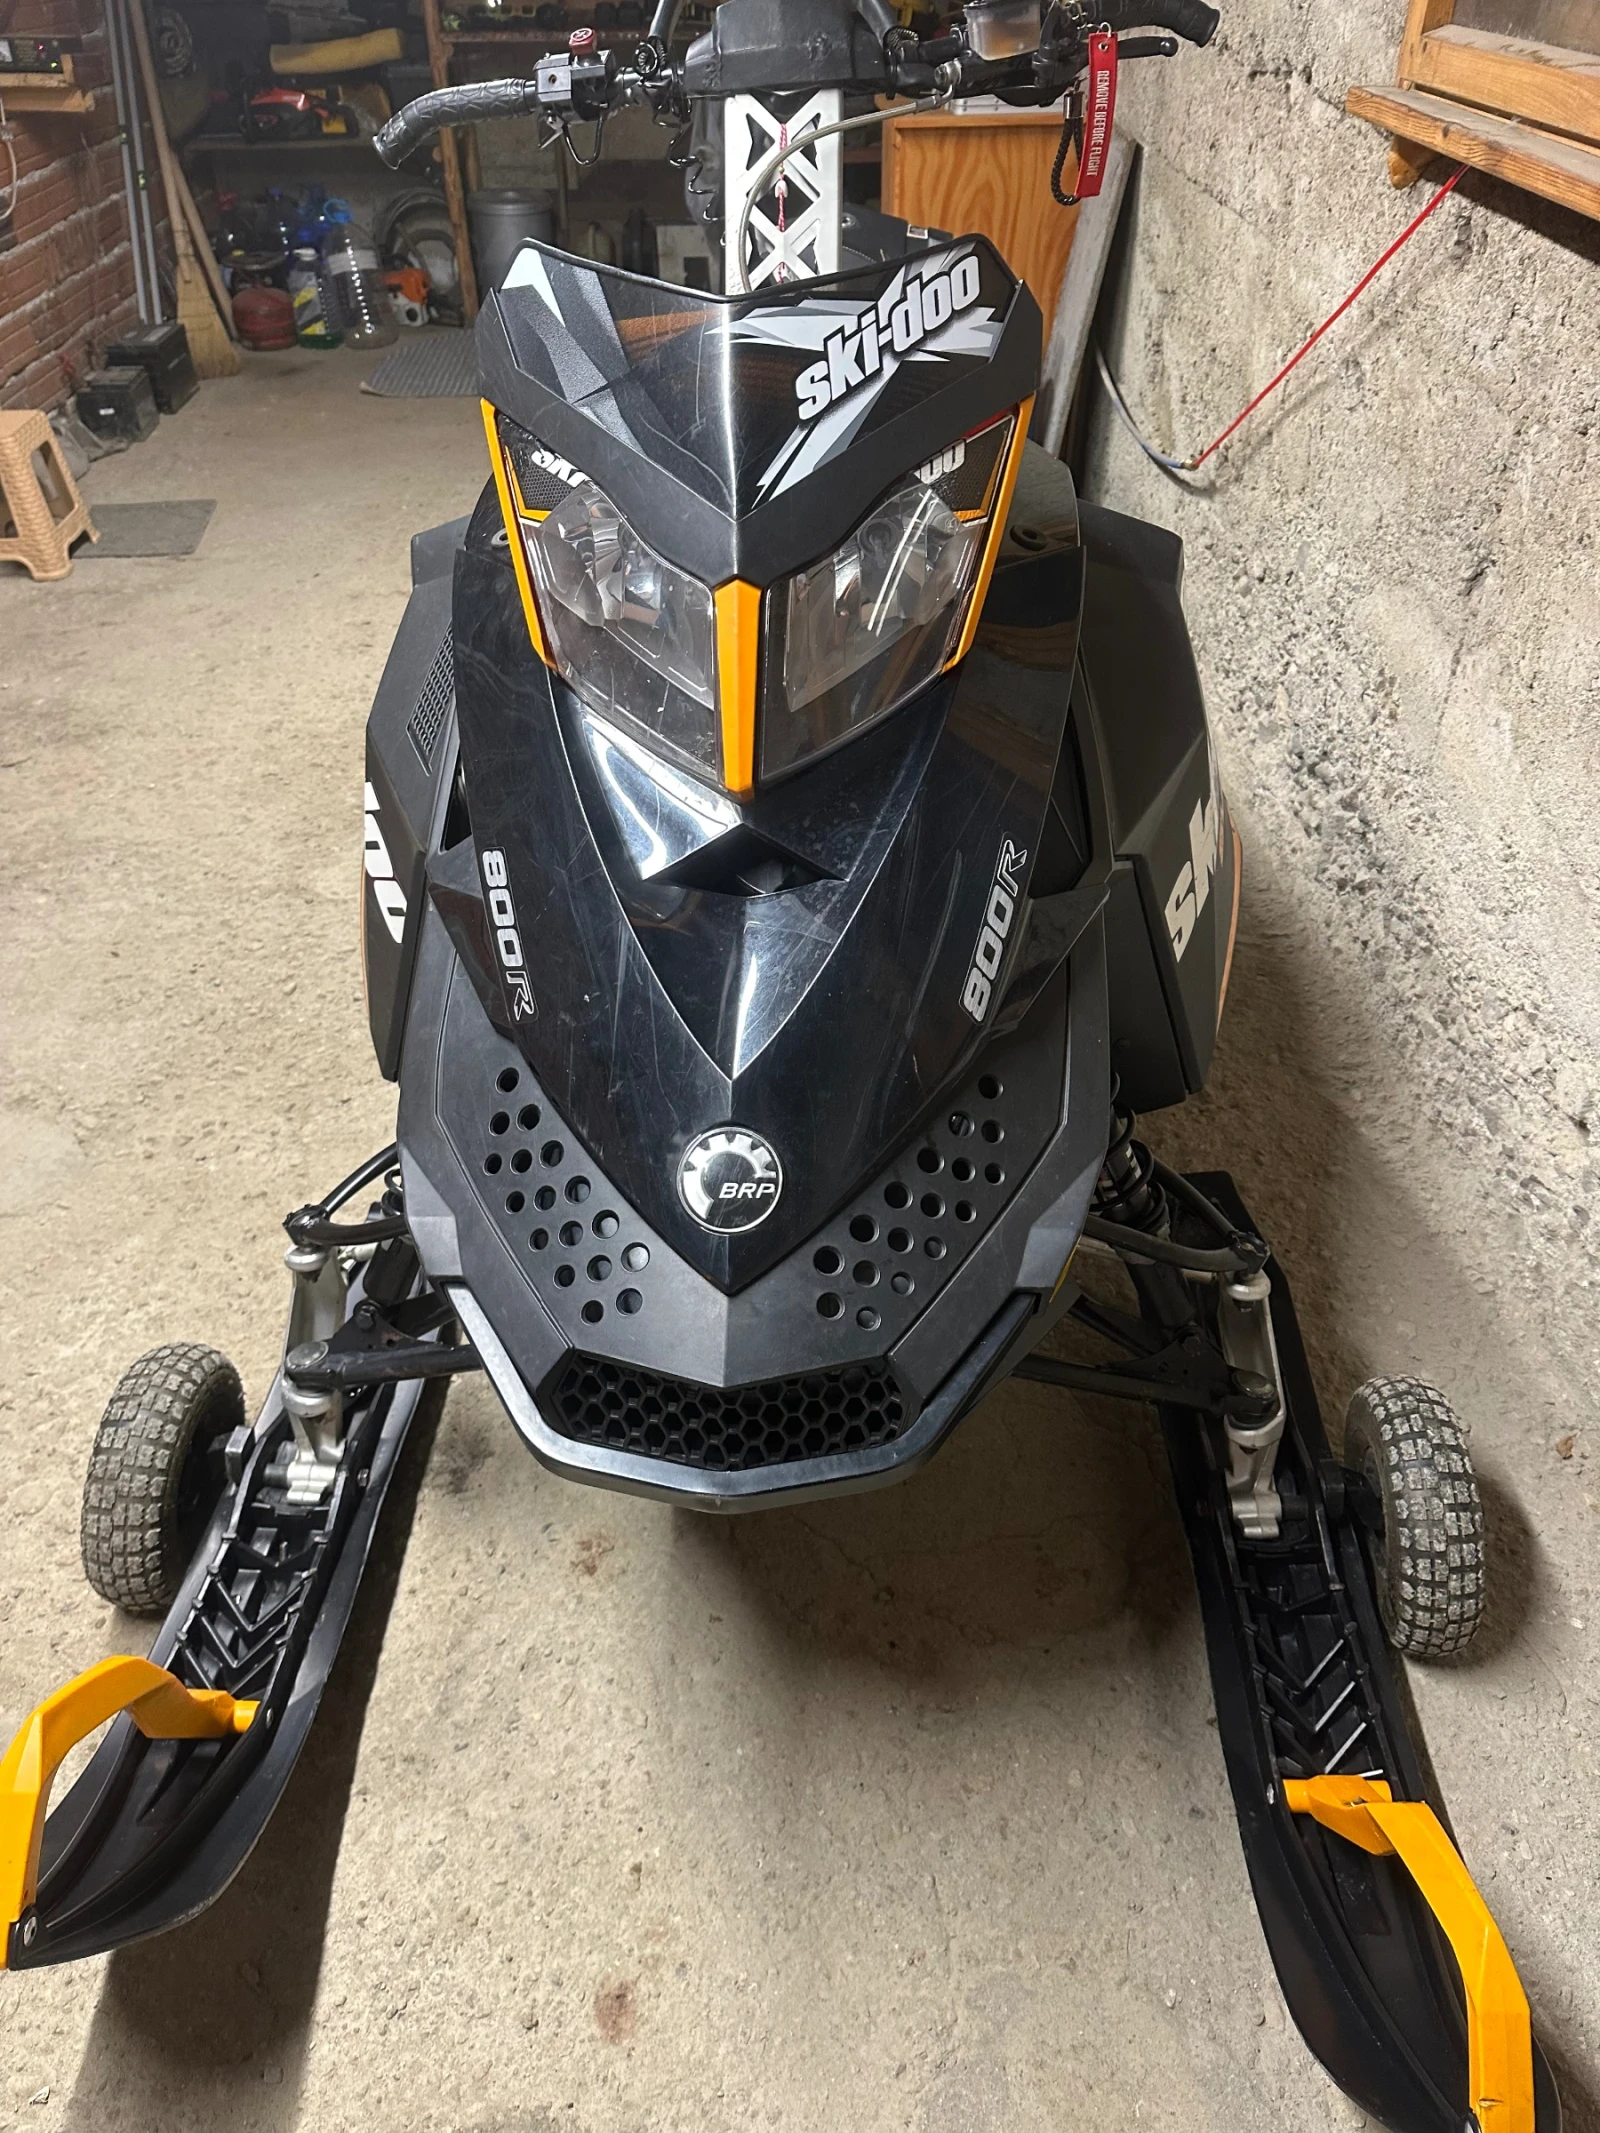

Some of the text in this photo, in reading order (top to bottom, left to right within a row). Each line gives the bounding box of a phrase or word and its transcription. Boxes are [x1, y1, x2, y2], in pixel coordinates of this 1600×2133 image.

[1086, 70, 1110, 176] REMOVE BEFORE FLIGHT
[795, 255, 980, 421] ski-doo
[481, 850, 535, 1021] 800R
[963, 839, 1028, 1022] 800R
[718, 1182, 777, 1199] BRP
